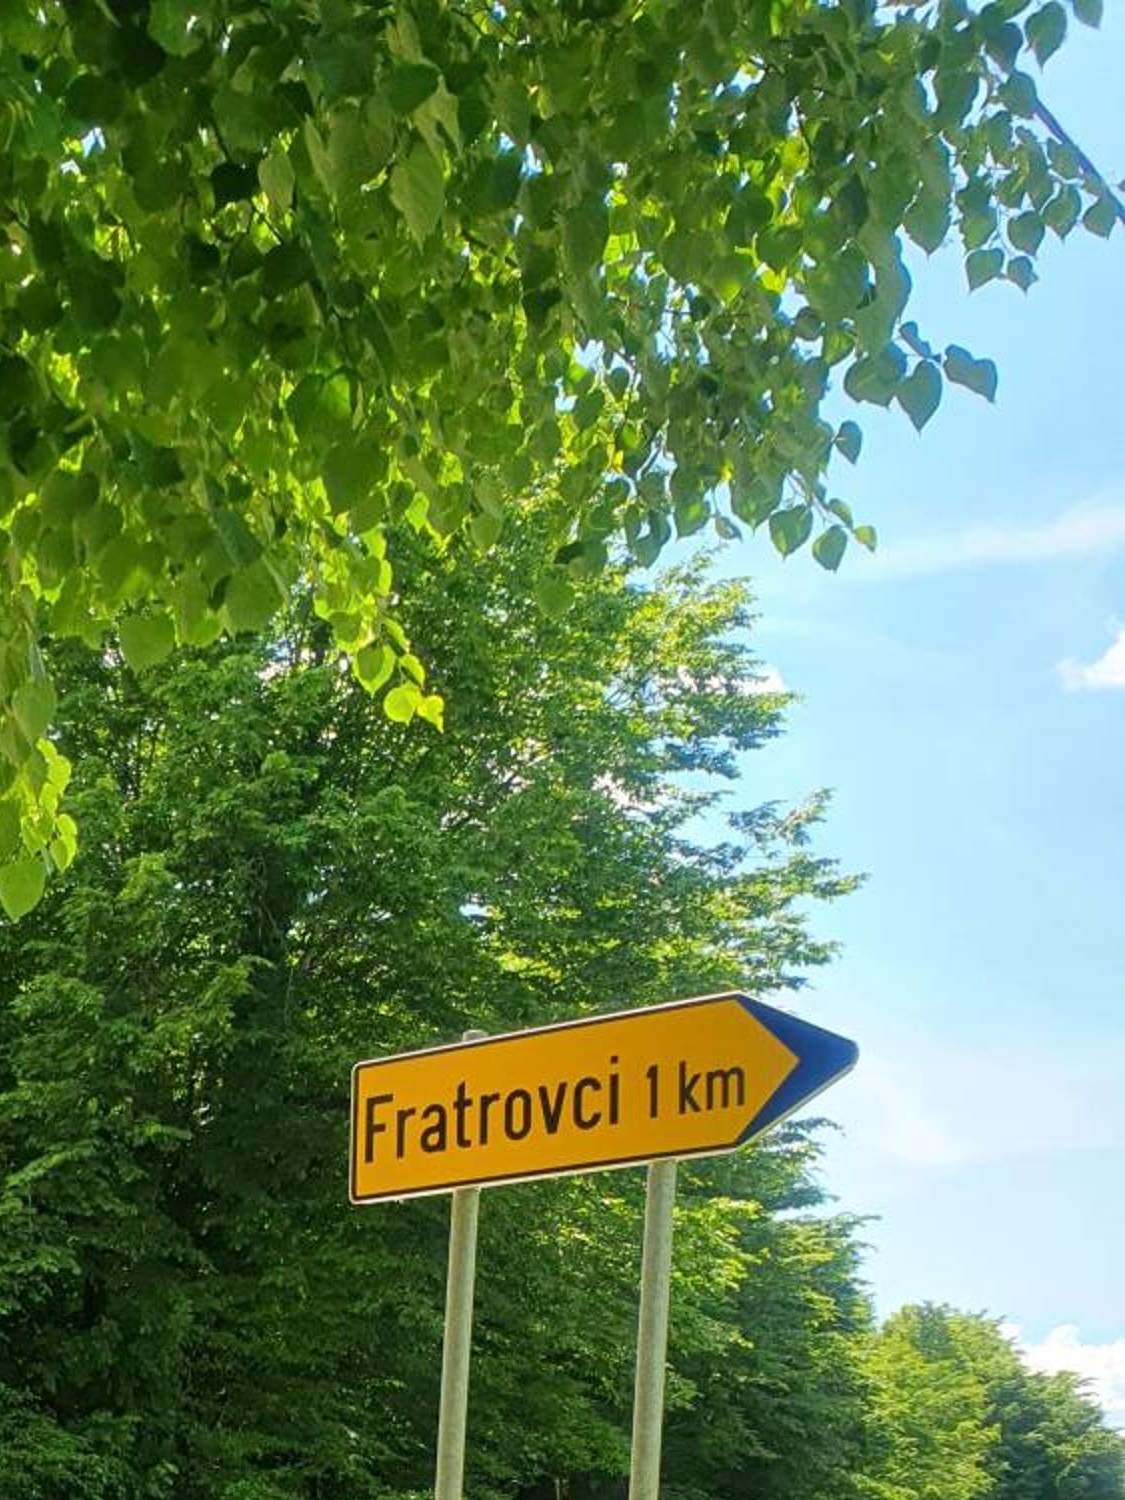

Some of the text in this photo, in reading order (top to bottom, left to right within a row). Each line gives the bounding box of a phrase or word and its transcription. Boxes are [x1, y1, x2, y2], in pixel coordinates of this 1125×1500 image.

[365, 1056, 746, 1163] Fratrovci 1 km
